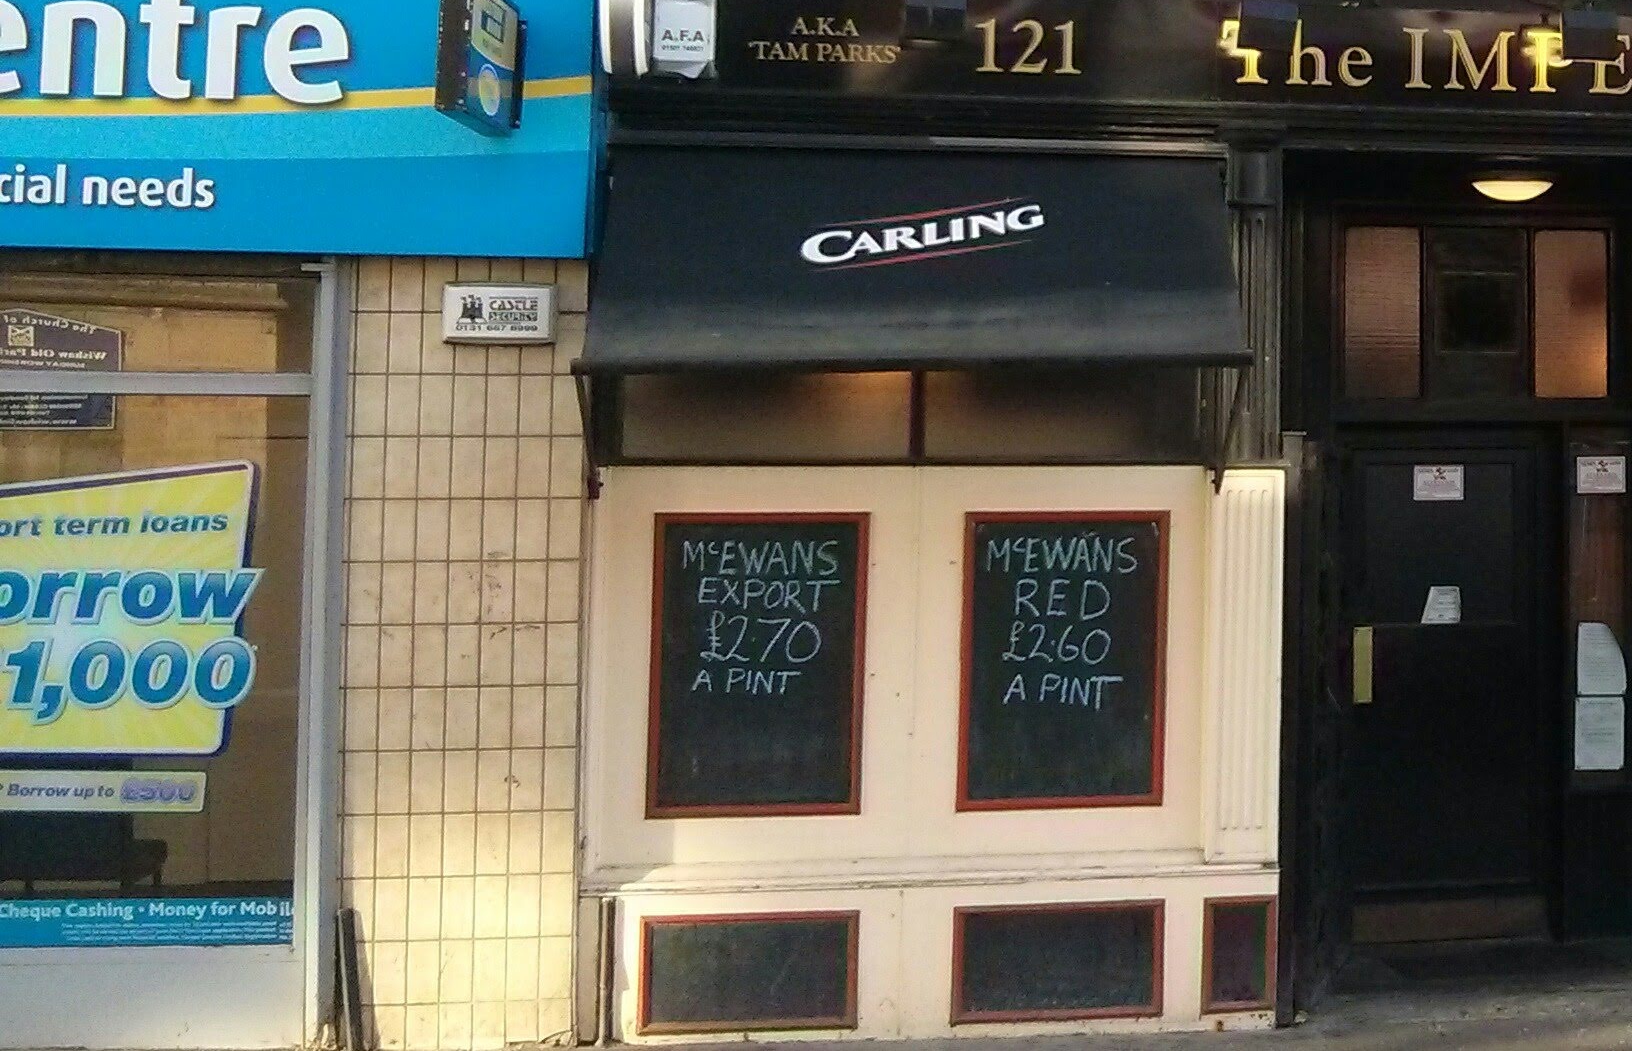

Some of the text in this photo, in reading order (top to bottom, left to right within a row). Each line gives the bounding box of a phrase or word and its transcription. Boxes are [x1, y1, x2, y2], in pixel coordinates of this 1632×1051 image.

[791, 17, 859, 38] A.K.A
[975, 17, 1082, 75] 121
[0, 164, 216, 208] cial needs
[800, 204, 1045, 264] CARLING
[489, 300, 539, 311] CASTLE
[0, 510, 229, 537] ort term loans
[0, 569, 262, 623] orrow
[698, 576, 842, 615] EXPORT
[1013, 578, 1112, 621] RED
[690, 667, 802, 696] A PINT
[1002, 672, 1125, 712] A PINT
[7, 783, 71, 798] Borrow
[74, 785, 94, 800] up
[97, 785, 115, 798] to
[0, 902, 61, 922] Cheque
[65, 903, 134, 921] Cashing
[149, 902, 205, 920] Money
[210, 901, 237, 917] for
